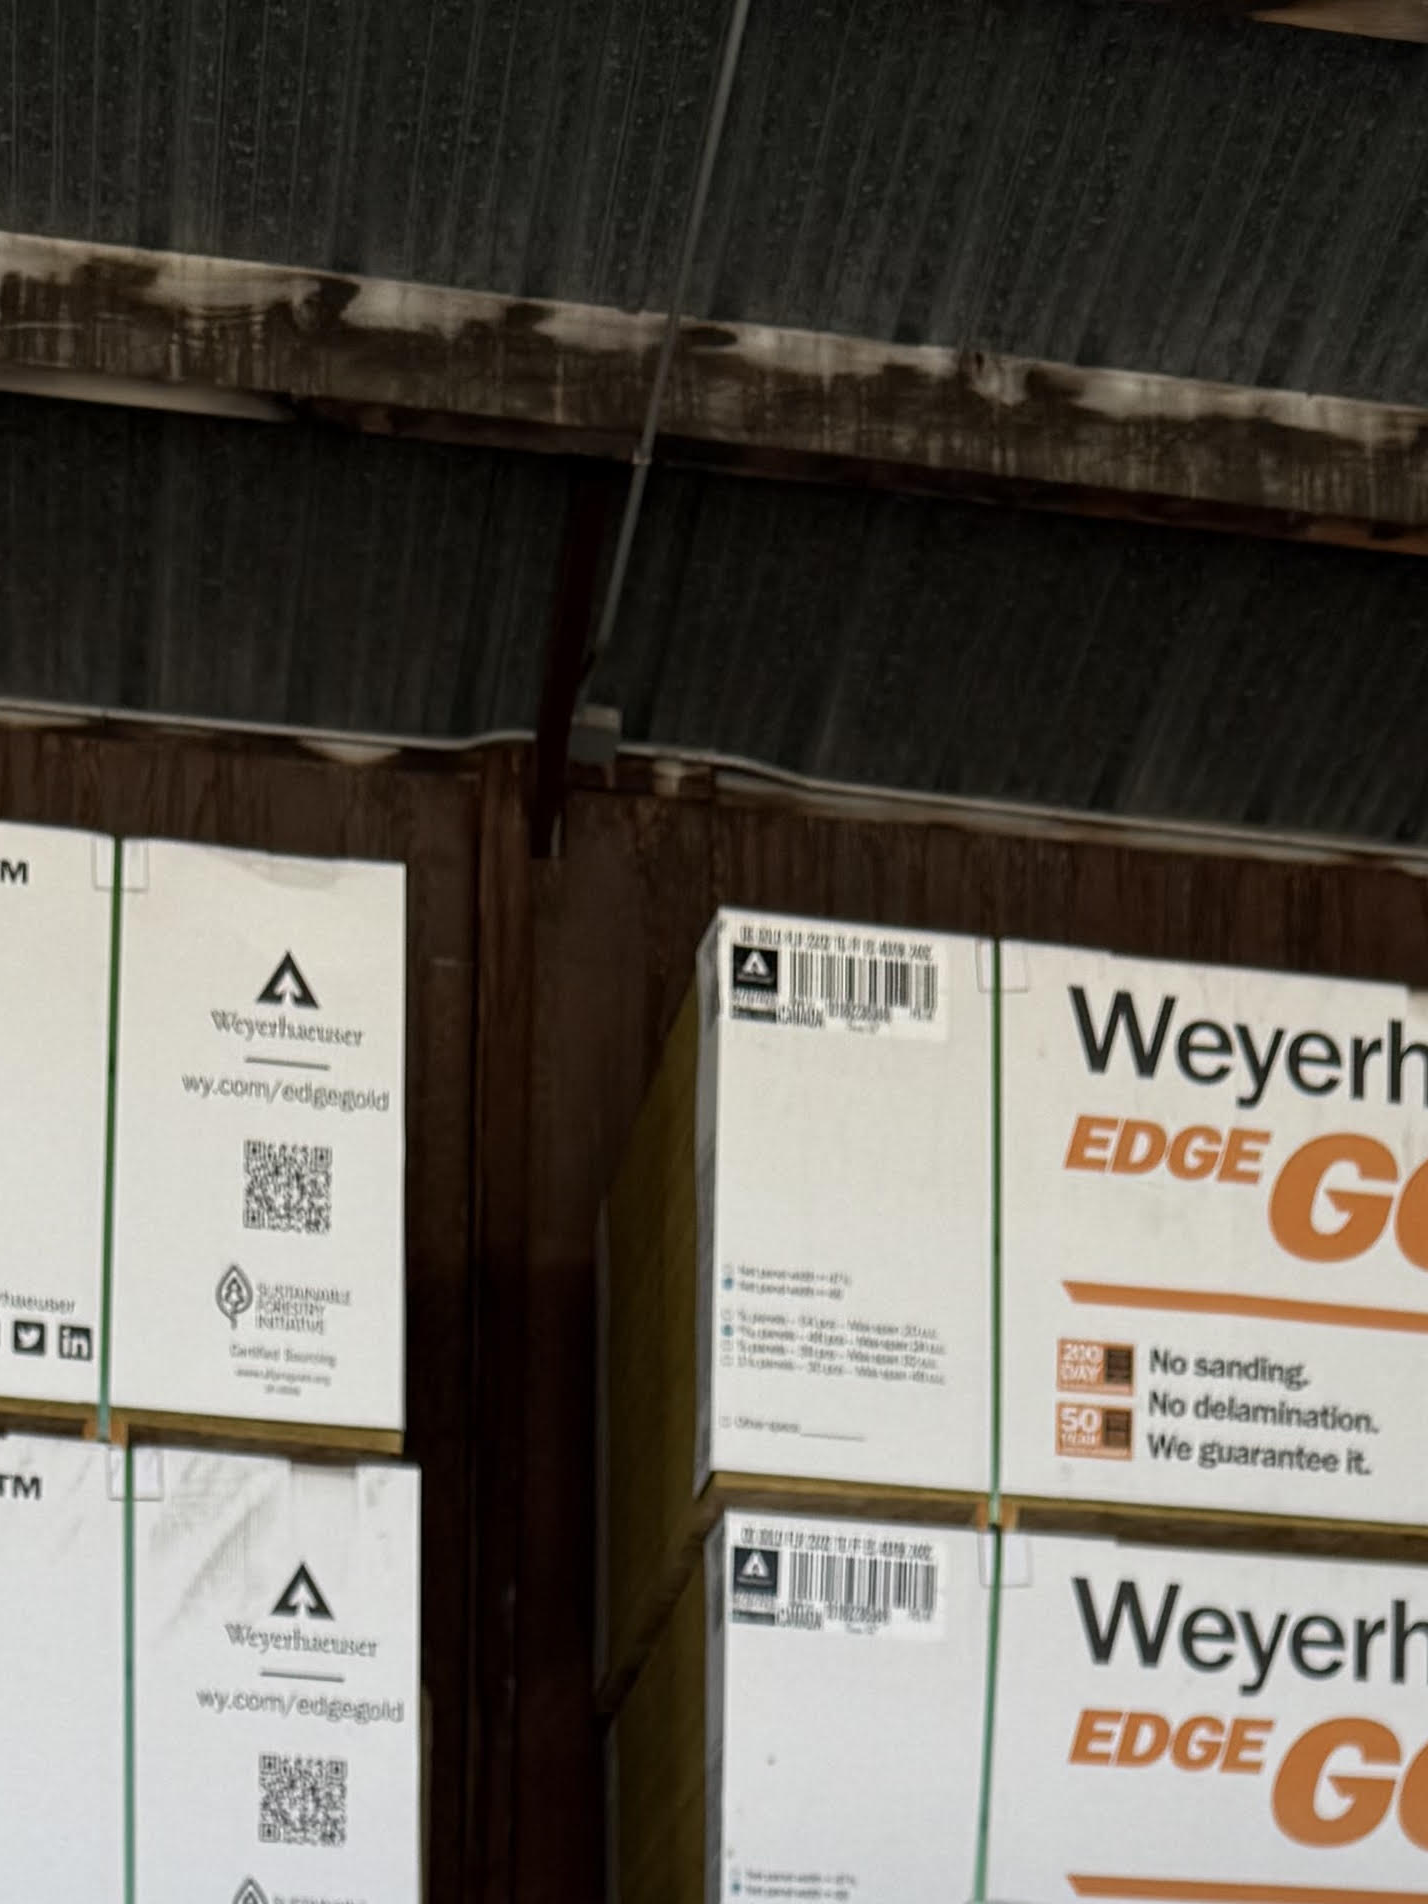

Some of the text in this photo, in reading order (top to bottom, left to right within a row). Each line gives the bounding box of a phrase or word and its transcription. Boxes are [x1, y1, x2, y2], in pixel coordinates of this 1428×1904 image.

[1064, 1115, 1271, 1185] EDGE
[1150, 1347, 1310, 1390] No sanding.
[1059, 1407, 1099, 1433] 50
[1148, 1390, 1379, 1434] No delamination.
[1147, 1433, 1371, 1476] We guarantee it.
[1069, 1708, 1274, 1773] EDGE
